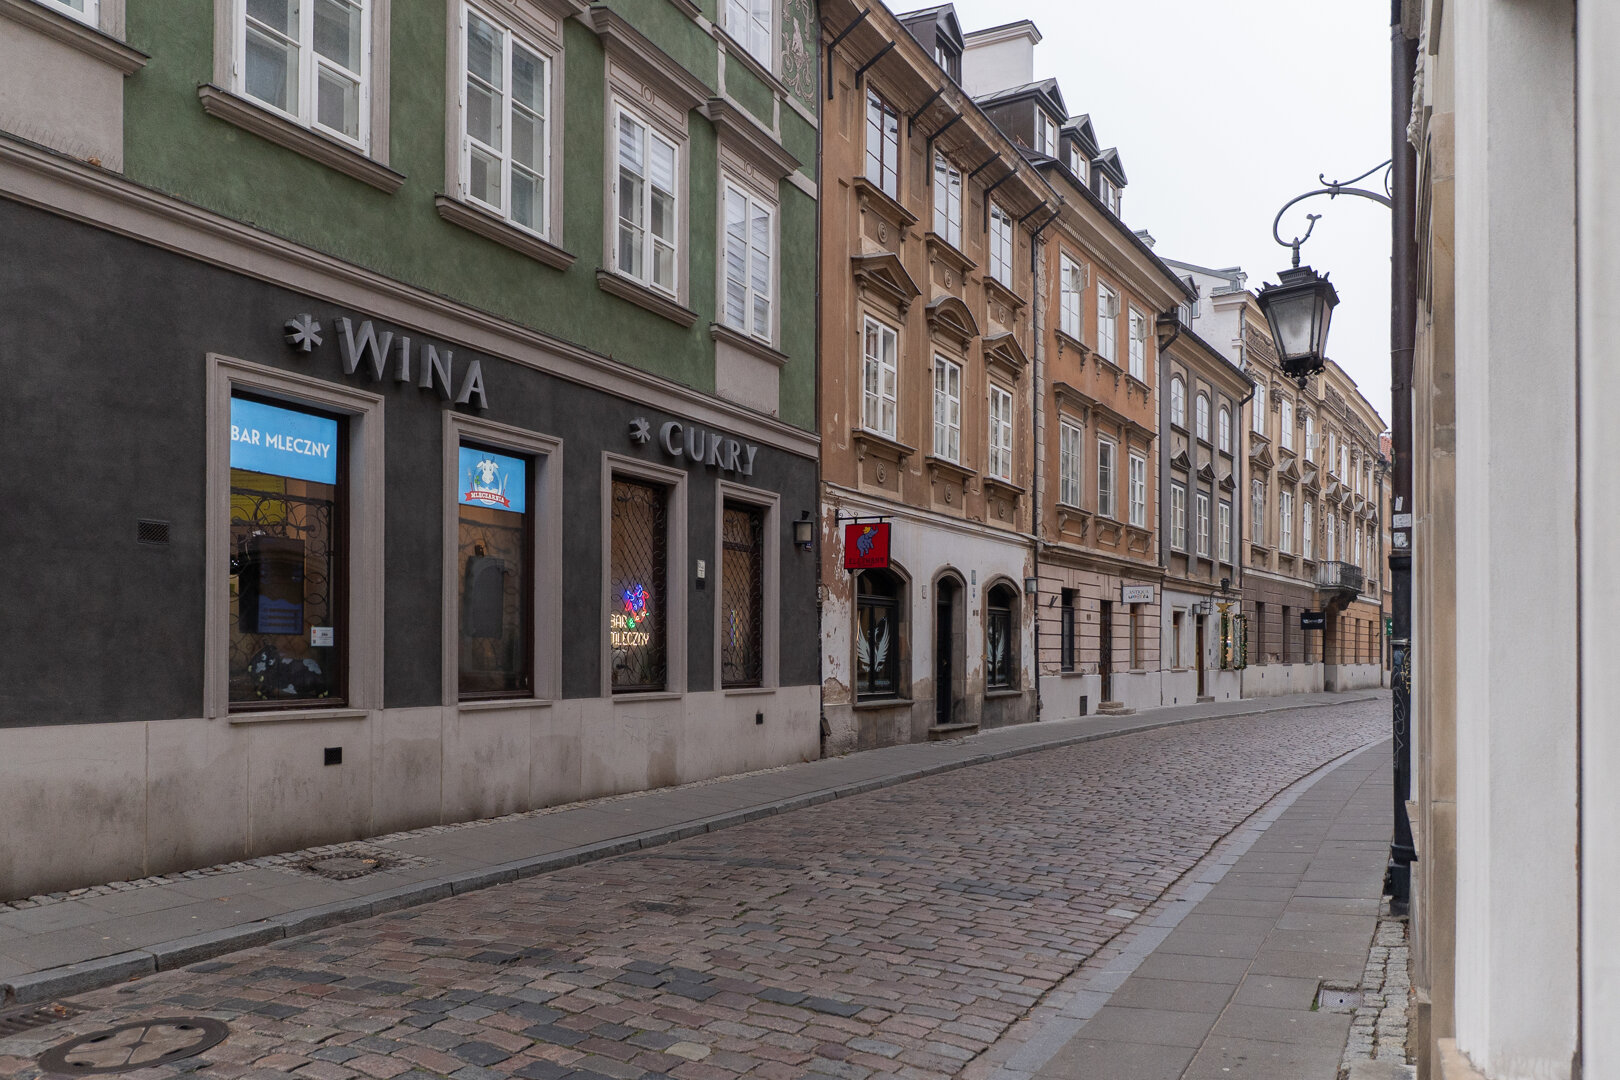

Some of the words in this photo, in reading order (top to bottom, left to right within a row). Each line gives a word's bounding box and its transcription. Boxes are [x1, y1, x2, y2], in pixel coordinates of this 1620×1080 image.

[334, 317, 489, 410] WINA
[231, 425, 260, 446] BAR
[265, 432, 330, 458] MLECZNY
[659, 421, 758, 476] CUKRY
[470, 492, 505, 503] MLECZARNIA
[610, 613, 627, 628] BAR
